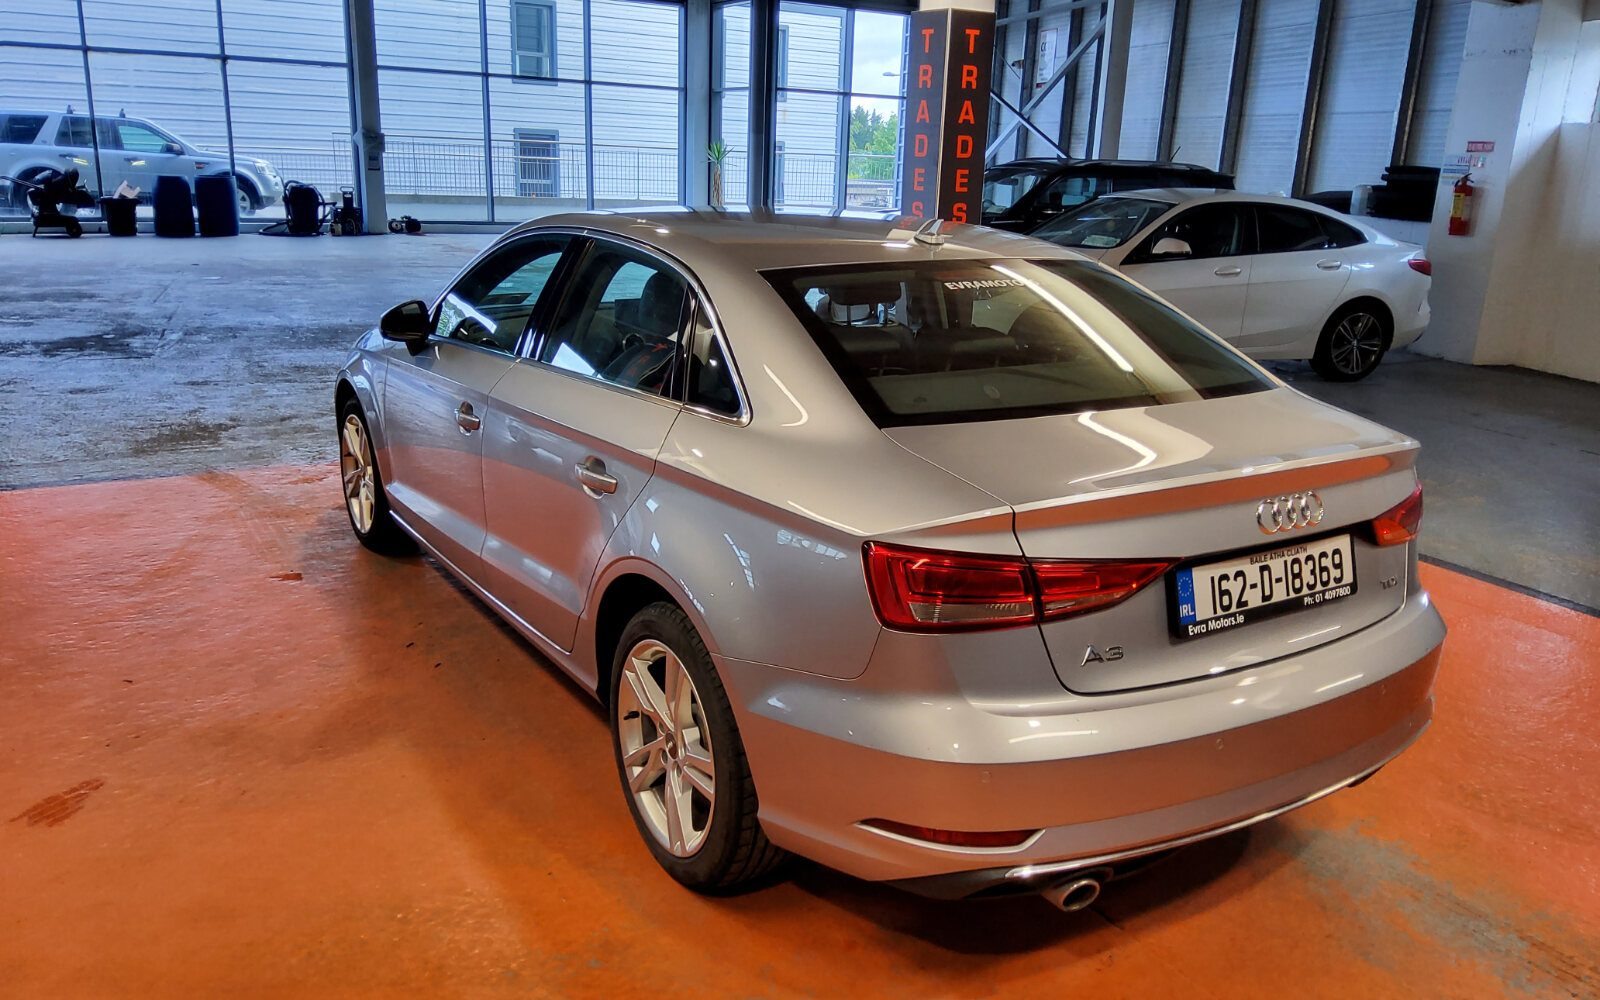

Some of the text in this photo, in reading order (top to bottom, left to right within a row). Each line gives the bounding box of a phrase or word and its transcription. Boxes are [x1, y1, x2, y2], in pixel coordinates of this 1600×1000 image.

[911, 28, 935, 218] TRADES
[952, 28, 981, 225] TRADES
[1249, 554, 1268, 565] BAILE
[1286, 546, 1308, 557] CLIATH
[1210, 547, 1344, 615] 162-D-18369
[1304, 586, 1351, 606] Ph: 01 4097800
[1179, 604, 1195, 618] IRL
[1188, 613, 1245, 636] Evra Motors.ie
[1081, 644, 1124, 666] A3
